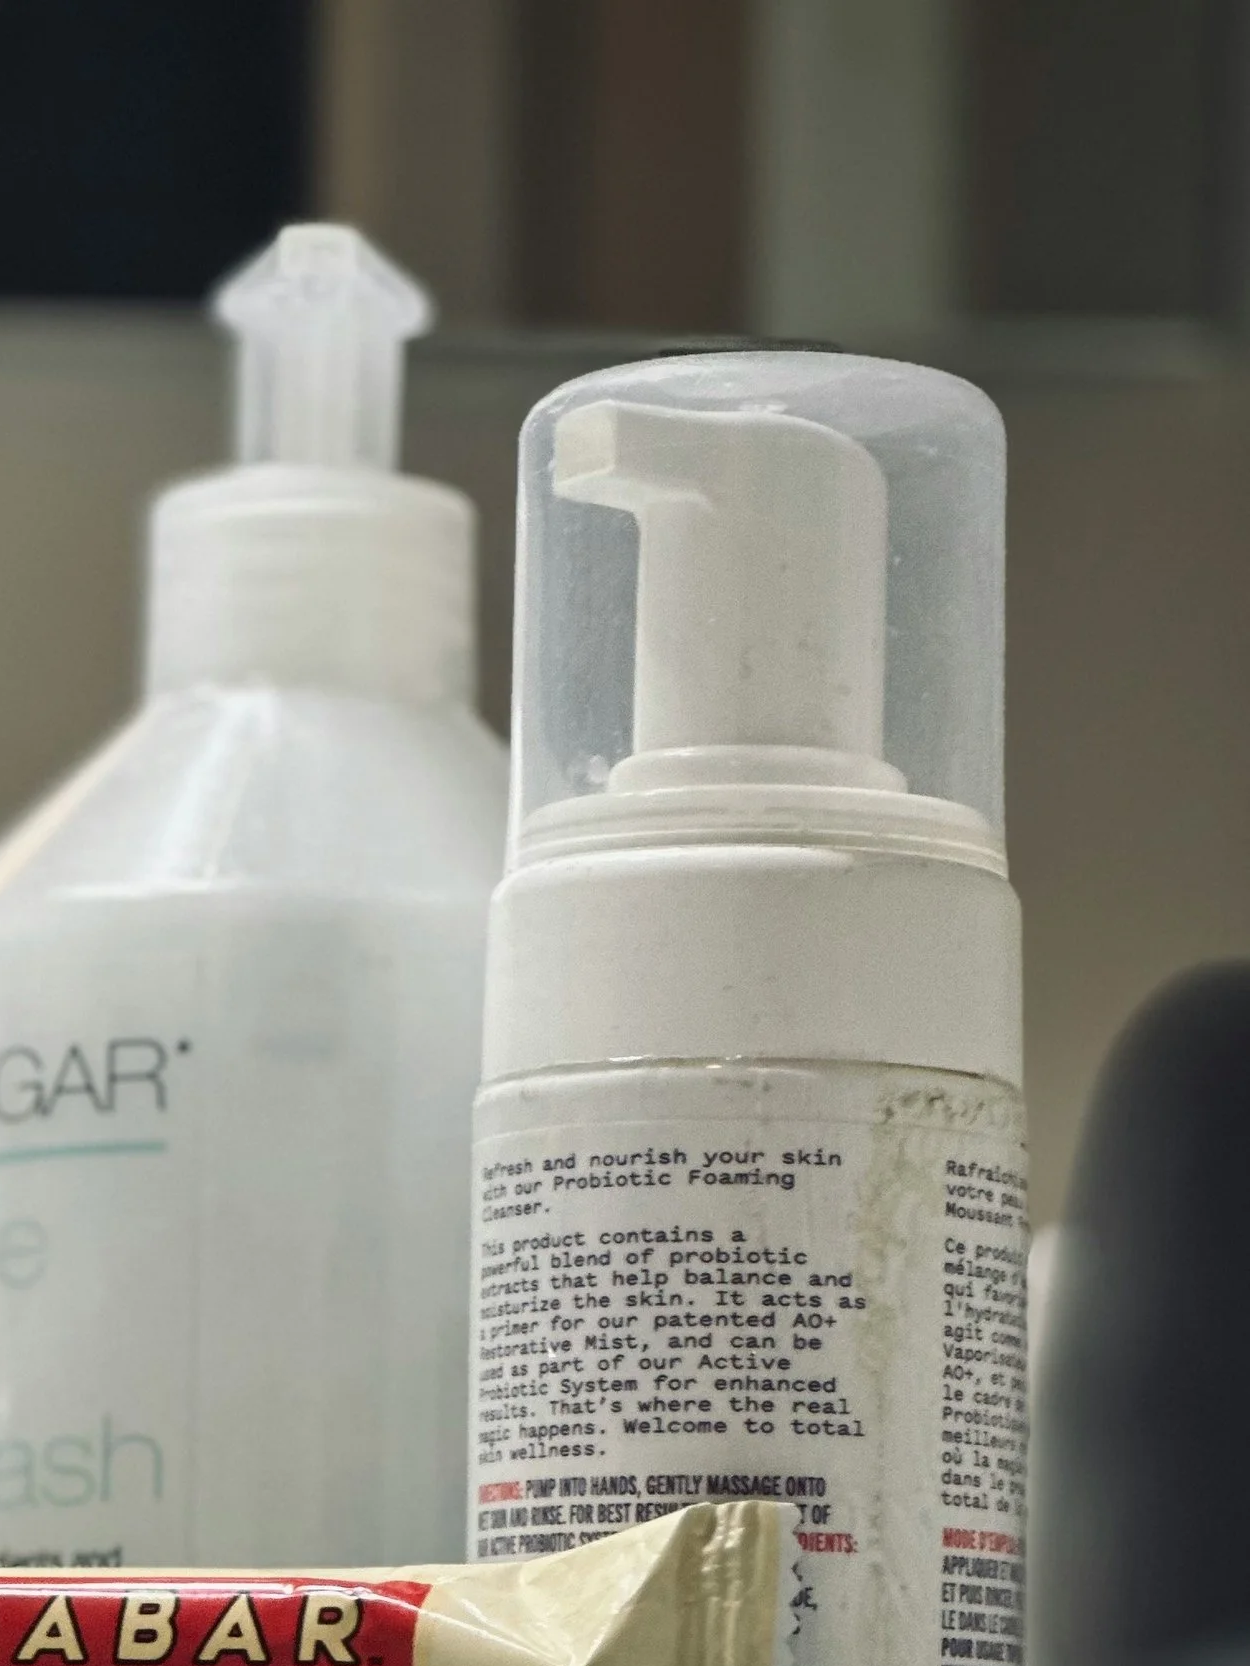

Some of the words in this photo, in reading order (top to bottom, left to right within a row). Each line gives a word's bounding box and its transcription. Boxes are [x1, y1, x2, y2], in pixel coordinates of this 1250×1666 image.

[542, 1153, 576, 1171] and
[589, 1148, 687, 1167] nourish
[703, 1149, 765, 1168] your
[782, 1148, 842, 1166] skin
[514, 1180, 543, 1196] our
[553, 1168, 672, 1191] Probiotic
[688, 1168, 795, 1190] Foaming
[945, 1183, 993, 1202] votre
[513, 1231, 586, 1253] product
[599, 1225, 714, 1245] contains
[731, 1229, 747, 1243] a
[945, 1237, 965, 1255] Ce
[550, 1250, 611, 1269] blend
[626, 1248, 655, 1265] of
[669, 1247, 808, 1268] probiotic
[550, 1272, 598, 1291] that
[612, 1268, 668, 1289] help
[684, 1268, 791, 1286] balance
[808, 1271, 854, 1288] and
[944, 1280, 974, 1300] qui
[574, 1293, 611, 1309] the
[626, 1289, 694, 1308] skin.
[716, 1290, 745, 1306] It
[761, 1291, 823, 1308] acts
[838, 1295, 867, 1310] as
[490, 1319, 539, 1340] primer
[550, 1315, 586, 1331] for
[598, 1315, 638, 1330] our
[654, 1312, 776, 1332] patented
[944, 1322, 982, 1343] agit
[584, 1333, 650, 1352] Mist,
[668, 1333, 713, 1349] and
[730, 1334, 776, 1349] can
[792, 1333, 823, 1350] be
[511, 1363, 529, 1377] as
[538, 1357, 584, 1378] part
[598, 1354, 625, 1371] of
[638, 1356, 682, 1371] our
[697, 1353, 791, 1370] Active
[560, 1377, 638, 1398] System
[653, 1374, 697, 1391] for
[714, 1376, 837, 1393] enhanced
[943, 1383, 963, 1402] le
[549, 1396, 623, 1416] That's
[638, 1396, 712, 1413] where
[729, 1396, 775, 1413] the
[792, 1398, 851, 1415] real
[518, 1421, 606, 1442] happens.
[623, 1417, 727, 1435] Welcome
[744, 1418, 775, 1434] to
[791, 1419, 865, 1437] total
[510, 1442, 606, 1460] wellness.
[942, 1446, 962, 1465] où
[974, 1449, 990, 1468] la
[559, 1476, 587, 1498] INTO
[590, 1474, 642, 1499] HANDS,
[646, 1473, 703, 1496] GENTLY
[707, 1474, 781, 1496] MASSAGE
[786, 1475, 827, 1498] ONTO
[942, 1468, 981, 1488] dans
[941, 1491, 989, 1510] total
[569, 1503, 594, 1525] FOR
[597, 1502, 632, 1523] BEST
[812, 1504, 831, 1525] OF
[941, 1581, 956, 1602] ET
[941, 1609, 956, 1630] LE
[941, 1637, 973, 1659] POUR
